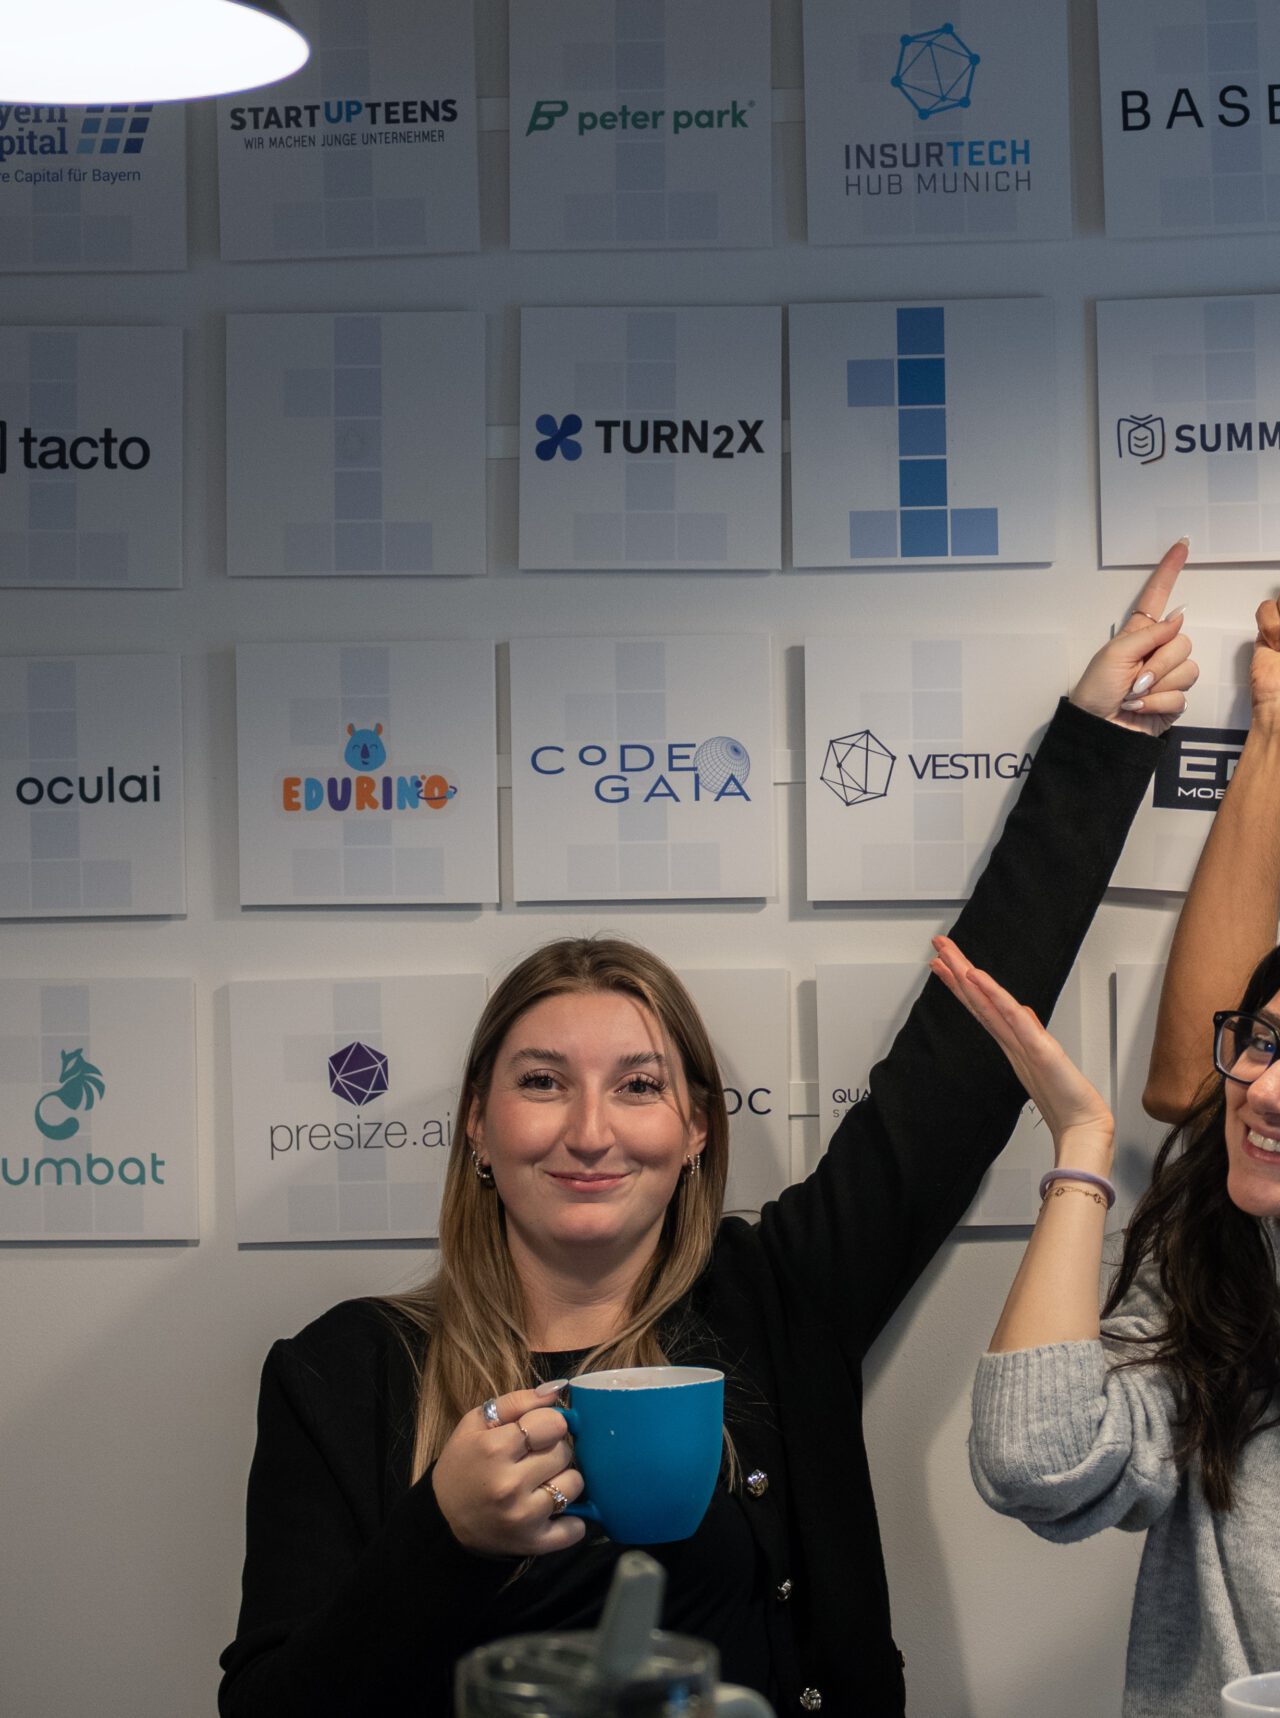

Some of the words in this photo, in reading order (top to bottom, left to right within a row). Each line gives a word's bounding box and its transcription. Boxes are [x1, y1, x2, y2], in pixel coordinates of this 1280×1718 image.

[578, 104, 664, 136] peter
[673, 101, 748, 134] park
[244, 137, 264, 149] WIR
[269, 136, 315, 148] MACHEN
[321, 133, 356, 146] JUNGE
[362, 130, 444, 145] UNTERNEHMER
[15, 168, 63, 184] Capital
[68, 168, 87, 181] für
[92, 168, 141, 184] Bayern
[845, 174, 902, 196] HUB
[917, 170, 1031, 194] MUNICH
[19, 427, 150, 470] tacto
[595, 420, 765, 459] TURN2X
[16, 765, 160, 805] oculai
[283, 775, 449, 812] EDURINO
[594, 773, 751, 803] GAIA
[270, 1111, 451, 1161] presize.ai
